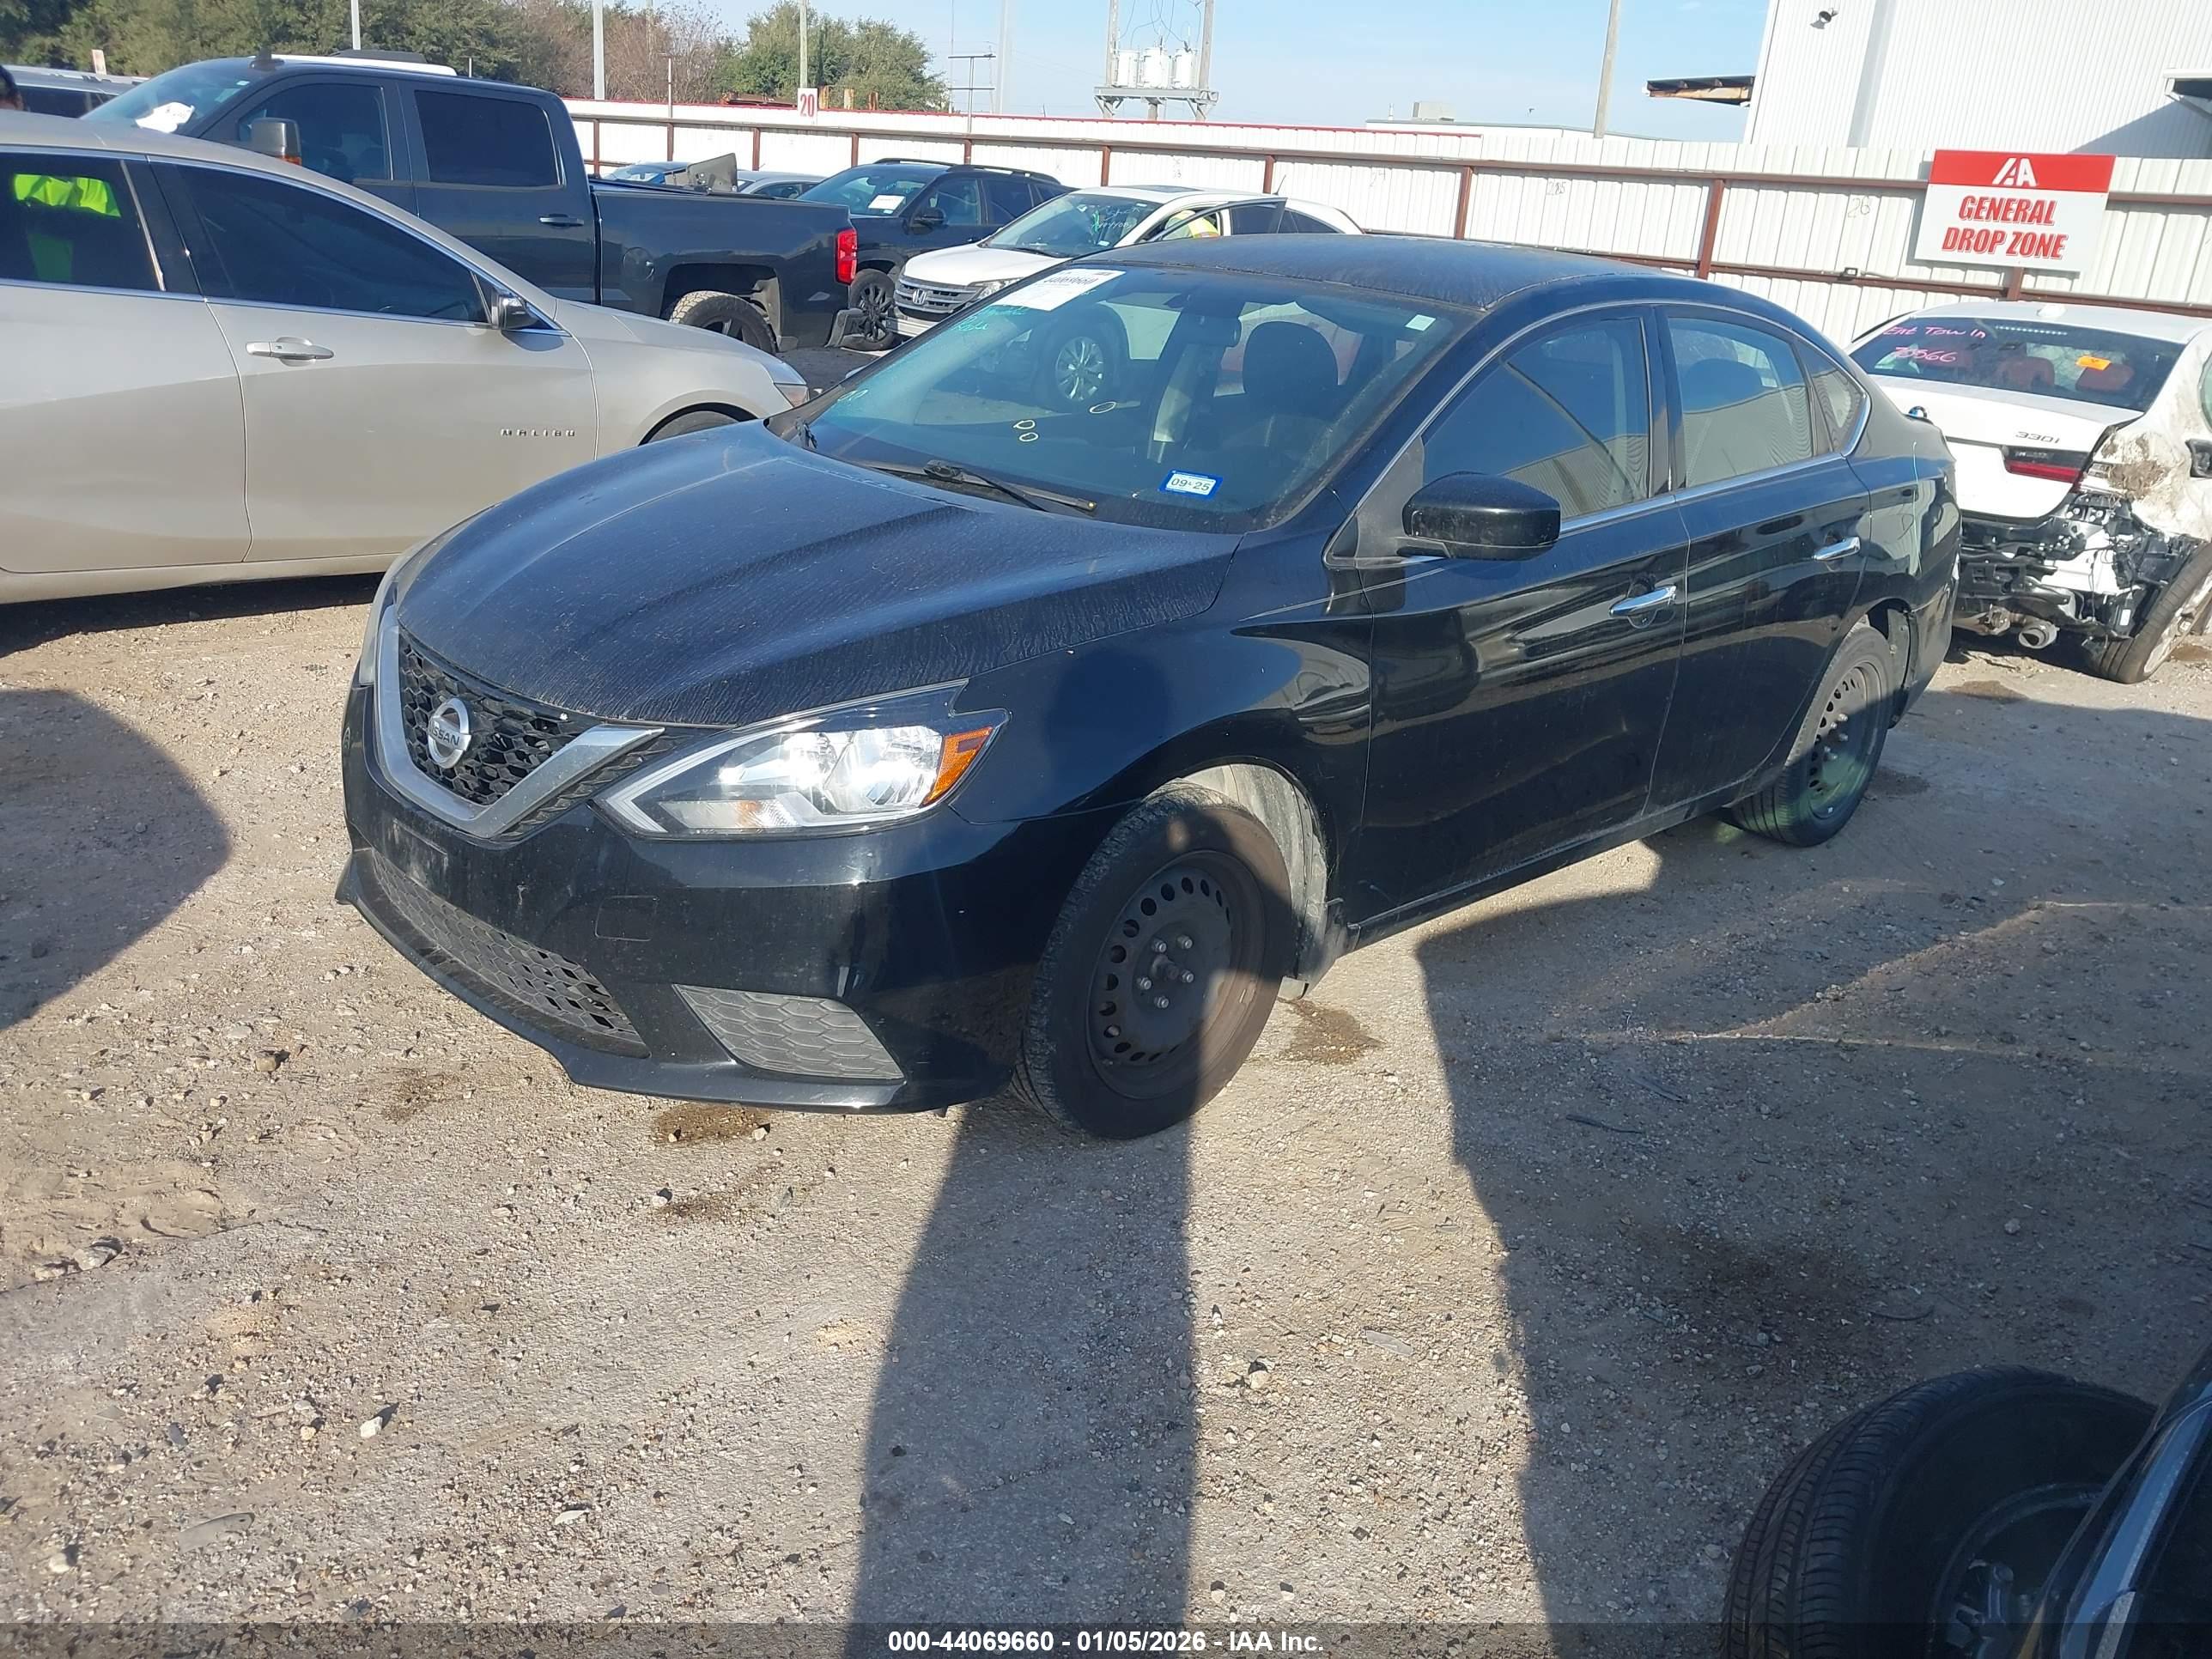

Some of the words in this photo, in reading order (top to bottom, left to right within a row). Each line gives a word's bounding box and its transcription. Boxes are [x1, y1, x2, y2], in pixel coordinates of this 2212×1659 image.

[799, 93, 815, 118] 20
[1958, 195, 2057, 226] GENERAL
[1941, 227, 2008, 255] DROP
[2006, 231, 2069, 260] ZONE
[500, 428, 575, 437] MALIBU
[1170, 477, 1188, 488] 09
[1192, 481, 1212, 492] 25
